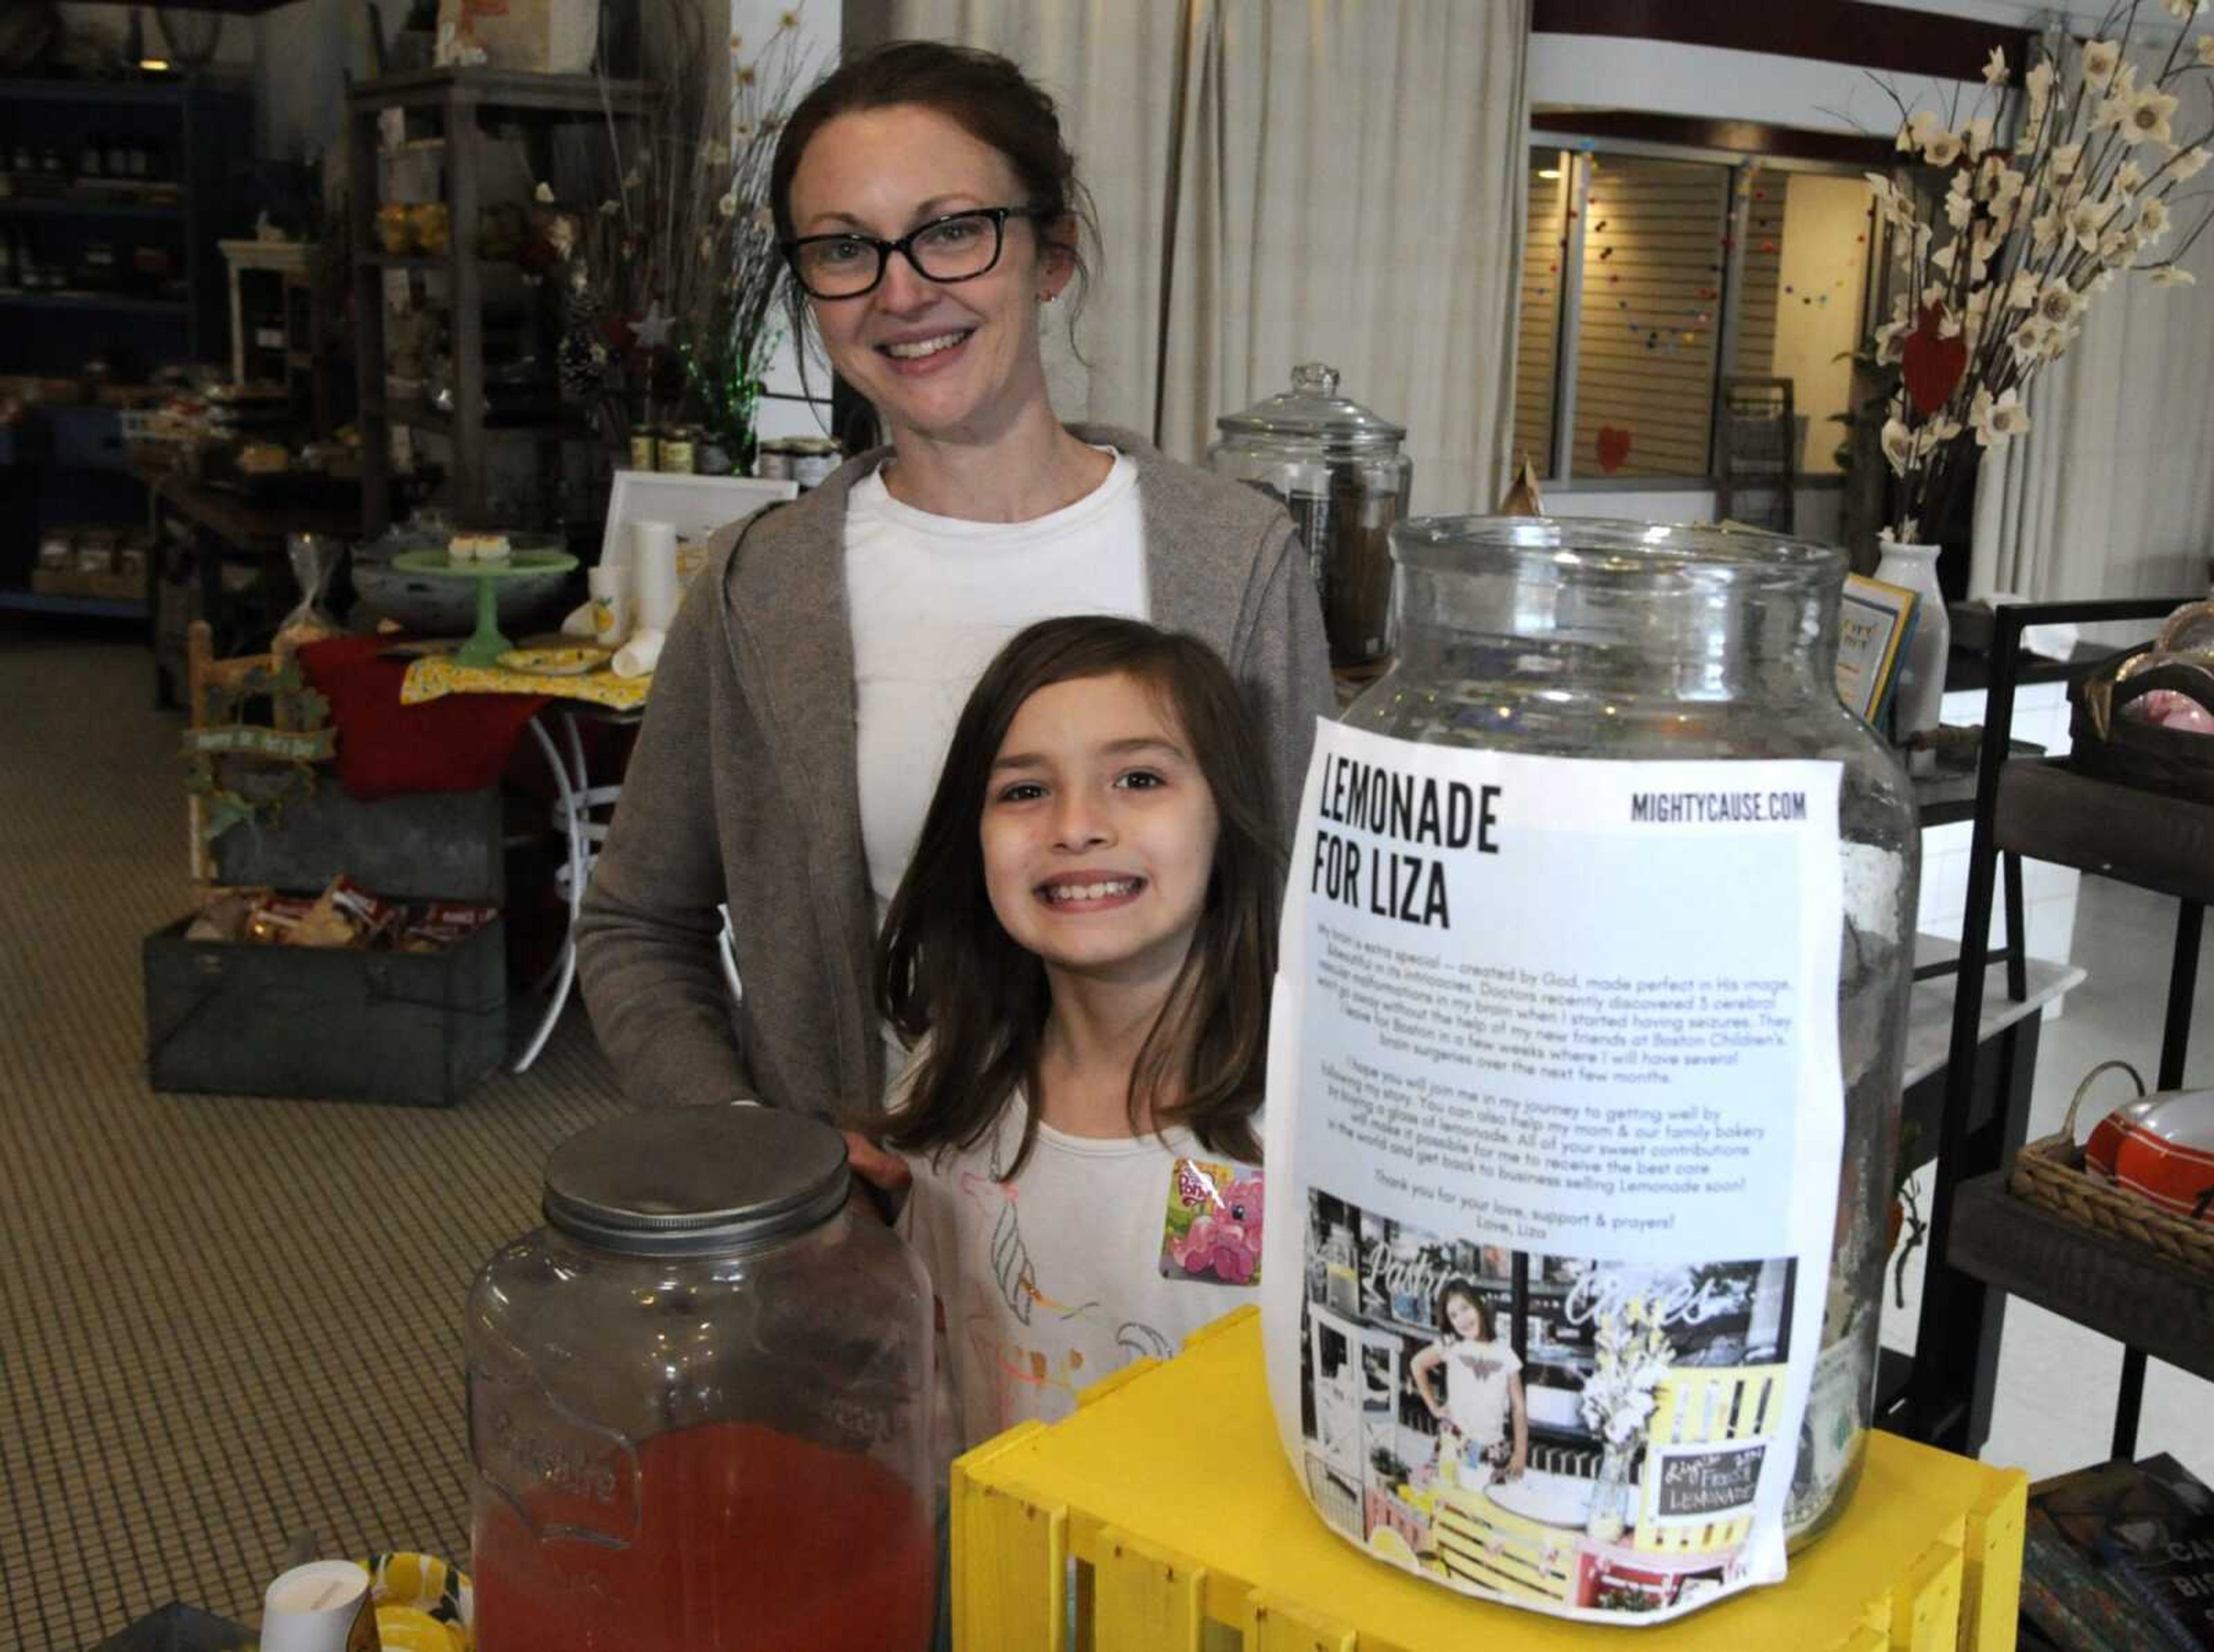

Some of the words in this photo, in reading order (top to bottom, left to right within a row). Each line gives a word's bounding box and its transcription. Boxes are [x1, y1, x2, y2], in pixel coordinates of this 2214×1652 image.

[1320, 752, 1501, 855] LEMONADE
[1631, 792, 1806, 821] MIGHTYCAUSE.COM
[1311, 830, 1358, 908] FOR
[1370, 847, 1450, 930] LIZA
[1387, 964, 1400, 976] its
[1403, 969, 1472, 993] intricacies.
[1480, 982, 1536, 1002] Doctors
[1541, 994, 1603, 1010] recently
[1609, 995, 1694, 1009] discovered
[1700, 997, 1707, 1009] 3
[1713, 997, 1775, 1009] cerebral
[1395, 950, 1439, 968] special
[1459, 964, 1515, 980] created
[1520, 970, 1537, 987] by
[1542, 972, 1579, 989] God,
[1585, 976, 1631, 990] made
[1636, 978, 1694, 994] perfect
[1699, 980, 1710, 991] in
[1716, 978, 1738, 990] His
[1743, 980, 1790, 994] image,
[1430, 1011, 1452, 1025] the
[1456, 1014, 1486, 1034] help
[1490, 1020, 1506, 1032] of
[1510, 1024, 1531, 1040] my
[1535, 1028, 1567, 1041] new
[1572, 1029, 1626, 1046] friends
[1631, 1035, 1648, 1046] at
[1651, 1034, 1704, 1046] Boston
[1709, 1034, 1786, 1046] Children's.
[1436, 994, 1448, 1005] in
[1451, 997, 1471, 1013] my
[1475, 998, 1512, 1015] brain
[1516, 1006, 1556, 1021] when
[1572, 1013, 1628, 1027] started
[1632, 1014, 1683, 1032] having
[1688, 1017, 1750, 1028] seizures.
[1759, 1015, 1792, 1031] They
[1392, 1017, 1435, 1037] Boston
[1439, 1029, 1451, 1040] in
[1453, 1032, 1464, 1042] a
[1468, 1032, 1494, 1048] few
[1499, 1040, 1545, 1057] weeks
[1549, 1046, 1598, 1062] where
[1611, 1051, 1637, 1063] will
[1642, 1051, 1679, 1064] have
[1683, 1051, 1738, 1064] several
[1414, 1042, 1473, 1063] surgeries
[1476, 1055, 1506, 1069] over
[1512, 1059, 1535, 1073] the
[1541, 1065, 1573, 1077] next
[1578, 1066, 1606, 1080] few
[1613, 1069, 1671, 1082] months.
[1405, 1077, 1426, 1089] will
[1428, 1081, 1454, 1096] join
[1456, 1088, 1478, 1100] me
[1483, 1091, 1495, 1103] in
[1499, 1096, 1520, 1111] my
[1524, 1099, 1579, 1120] journey
[1584, 1106, 1601, 1118] to
[1606, 1108, 1661, 1123] getting
[1667, 1107, 1698, 1119] well
[1703, 1107, 1721, 1123] by
[1419, 1095, 1444, 1112] You
[1447, 1104, 1474, 1118] can
[1477, 1108, 1506, 1123] also
[1510, 1112, 1543, 1133] help
[1547, 1121, 1569, 1135] my
[1573, 1123, 1613, 1136] mom
[1617, 1124, 1628, 1136] &
[1635, 1128, 1660, 1138] our
[1665, 1126, 1710, 1142] family
[1715, 1126, 1765, 1142] bakery
[1387, 1106, 1417, 1122] glass
[1421, 1115, 1435, 1125] of
[1439, 1117, 1509, 1142] lemonade.
[1517, 1131, 1536, 1146] All
[1539, 1137, 1556, 1149] of
[1561, 1141, 1594, 1155] your
[1598, 1145, 1646, 1155] sweet
[1650, 1144, 1749, 1156] contributions
[1403, 1129, 1413, 1140] it
[1415, 1132, 1469, 1153] possible
[1473, 1142, 1493, 1156] for
[1497, 1148, 1520, 1161] me
[1524, 1152, 1540, 1165] to
[1544, 1157, 1601, 1171] receive
[1606, 1160, 1632, 1173] the
[1637, 1161, 1670, 1174] best
[1674, 1165, 1710, 1174] care
[1389, 1141, 1413, 1155] and
[1416, 1152, 1439, 1166] get
[1441, 1152, 1475, 1172] back
[1479, 1163, 1494, 1175] to
[1498, 1164, 1561, 1186] business
[1565, 1176, 1614, 1194] selling
[1619, 1179, 1700, 1193] Lemonade
[1704, 1179, 1746, 1193] soon!
[1410, 1184, 1434, 1198] you
[1437, 1189, 1456, 1203] for
[1459, 1195, 1489, 1210] your
[1493, 1199, 1525, 1218] love,
[1531, 1209, 1590, 1226] support
[1595, 1213, 1606, 1226] &
[1611, 1216, 1675, 1232] prayers!
[1476, 1215, 1513, 1235] Love,
[1517, 1223, 1546, 1239] Liza
